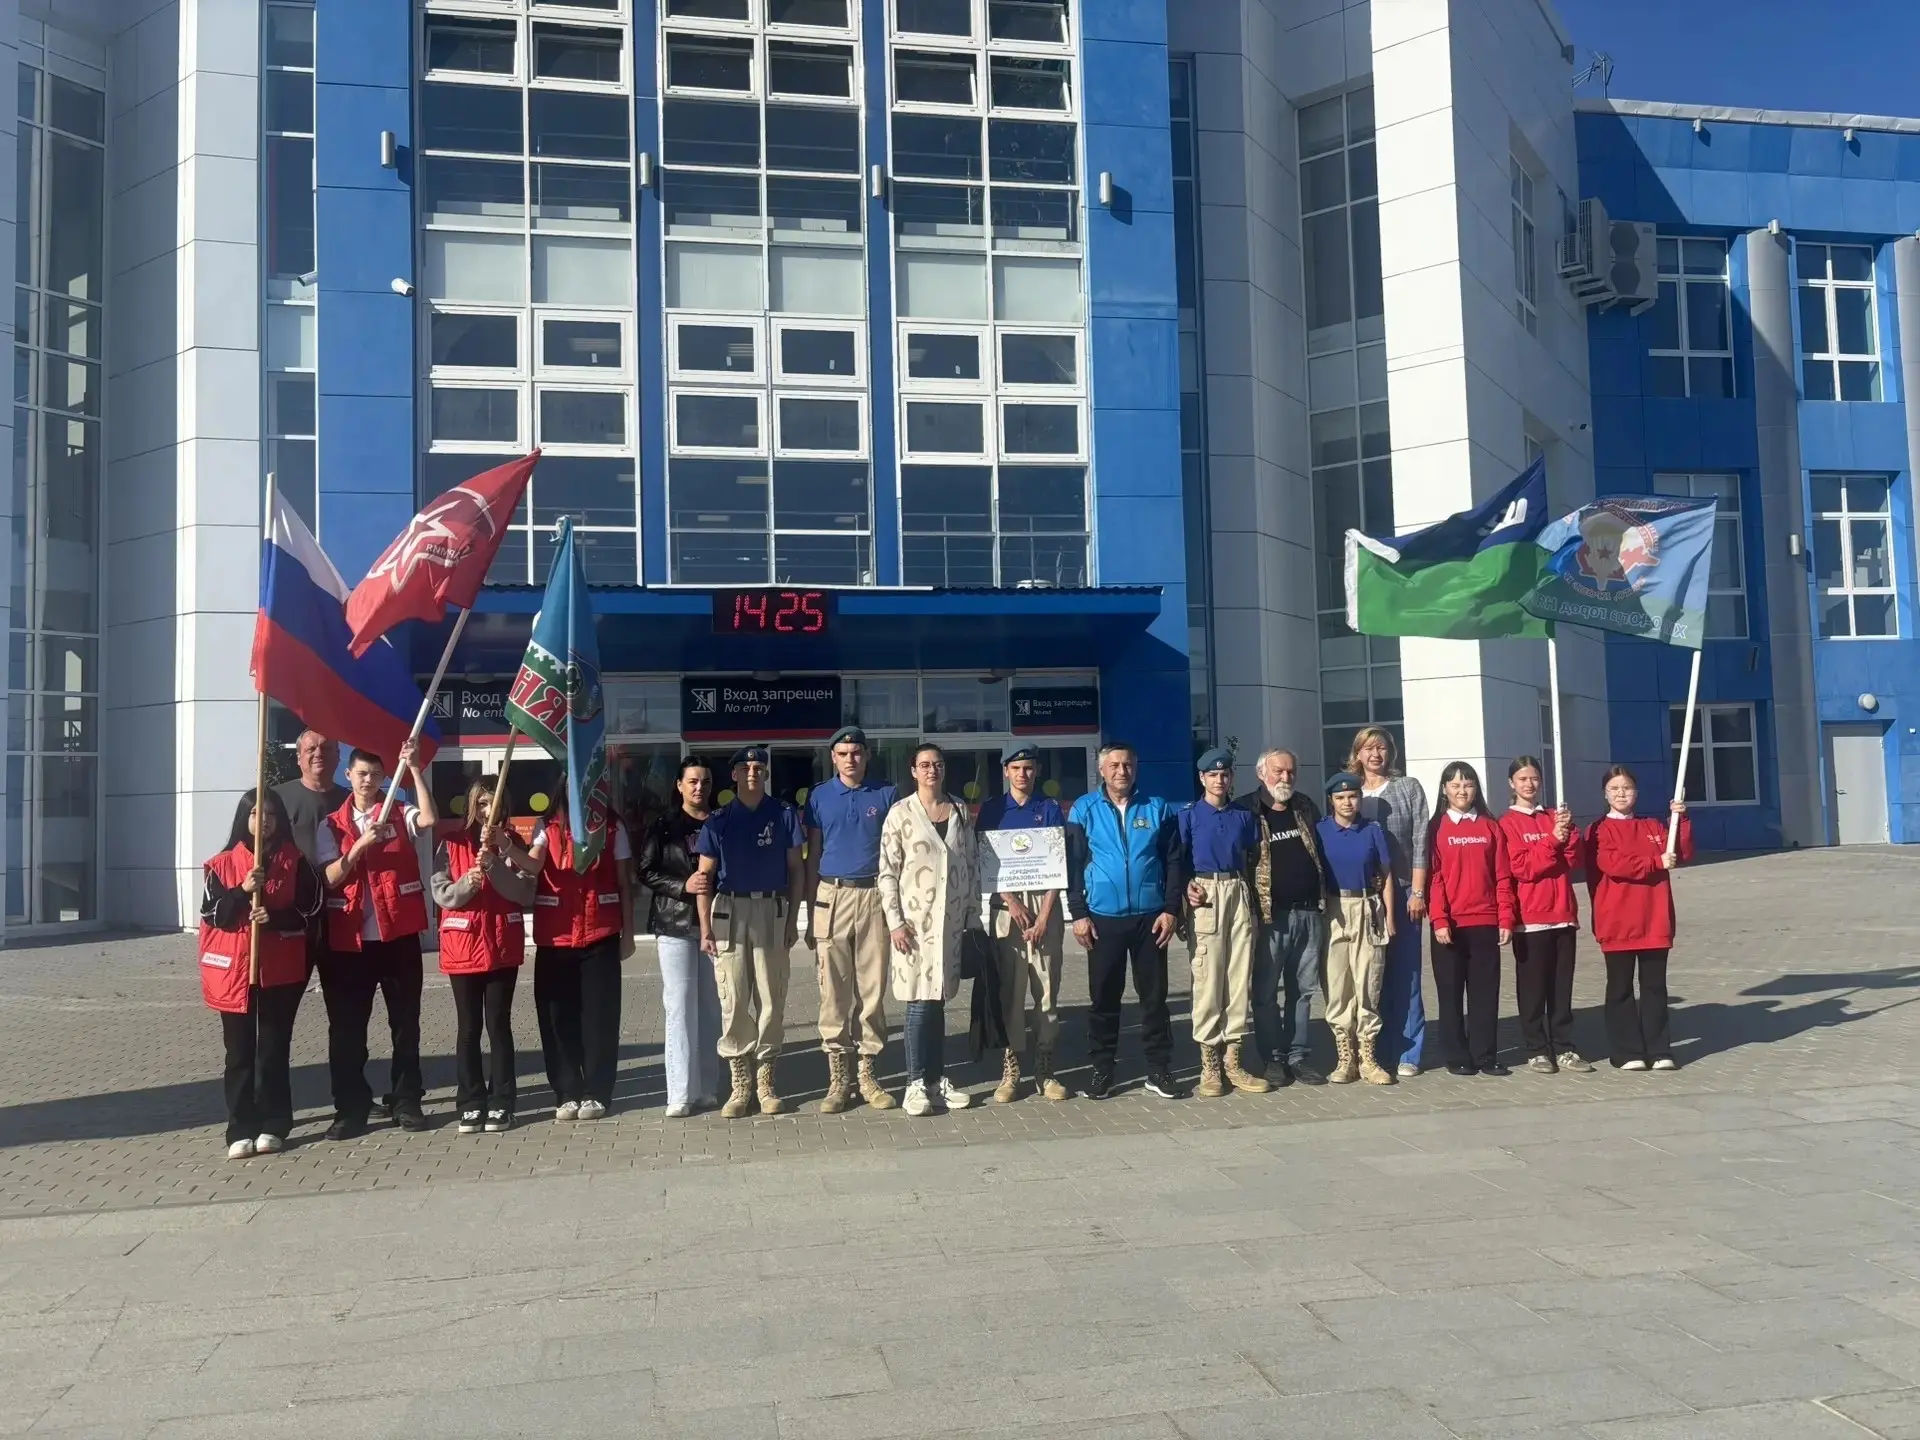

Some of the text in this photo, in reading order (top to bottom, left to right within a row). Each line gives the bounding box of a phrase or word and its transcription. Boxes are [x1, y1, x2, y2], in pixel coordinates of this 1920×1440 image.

[461, 690, 501, 706] Вход
[723, 688, 834, 703] Вход запрещен
[724, 703, 771, 715] No entry
[1032, 700, 1093, 708] Вход запрещен
[462, 707, 480, 719] No
[1447, 835, 1488, 847] Первые
